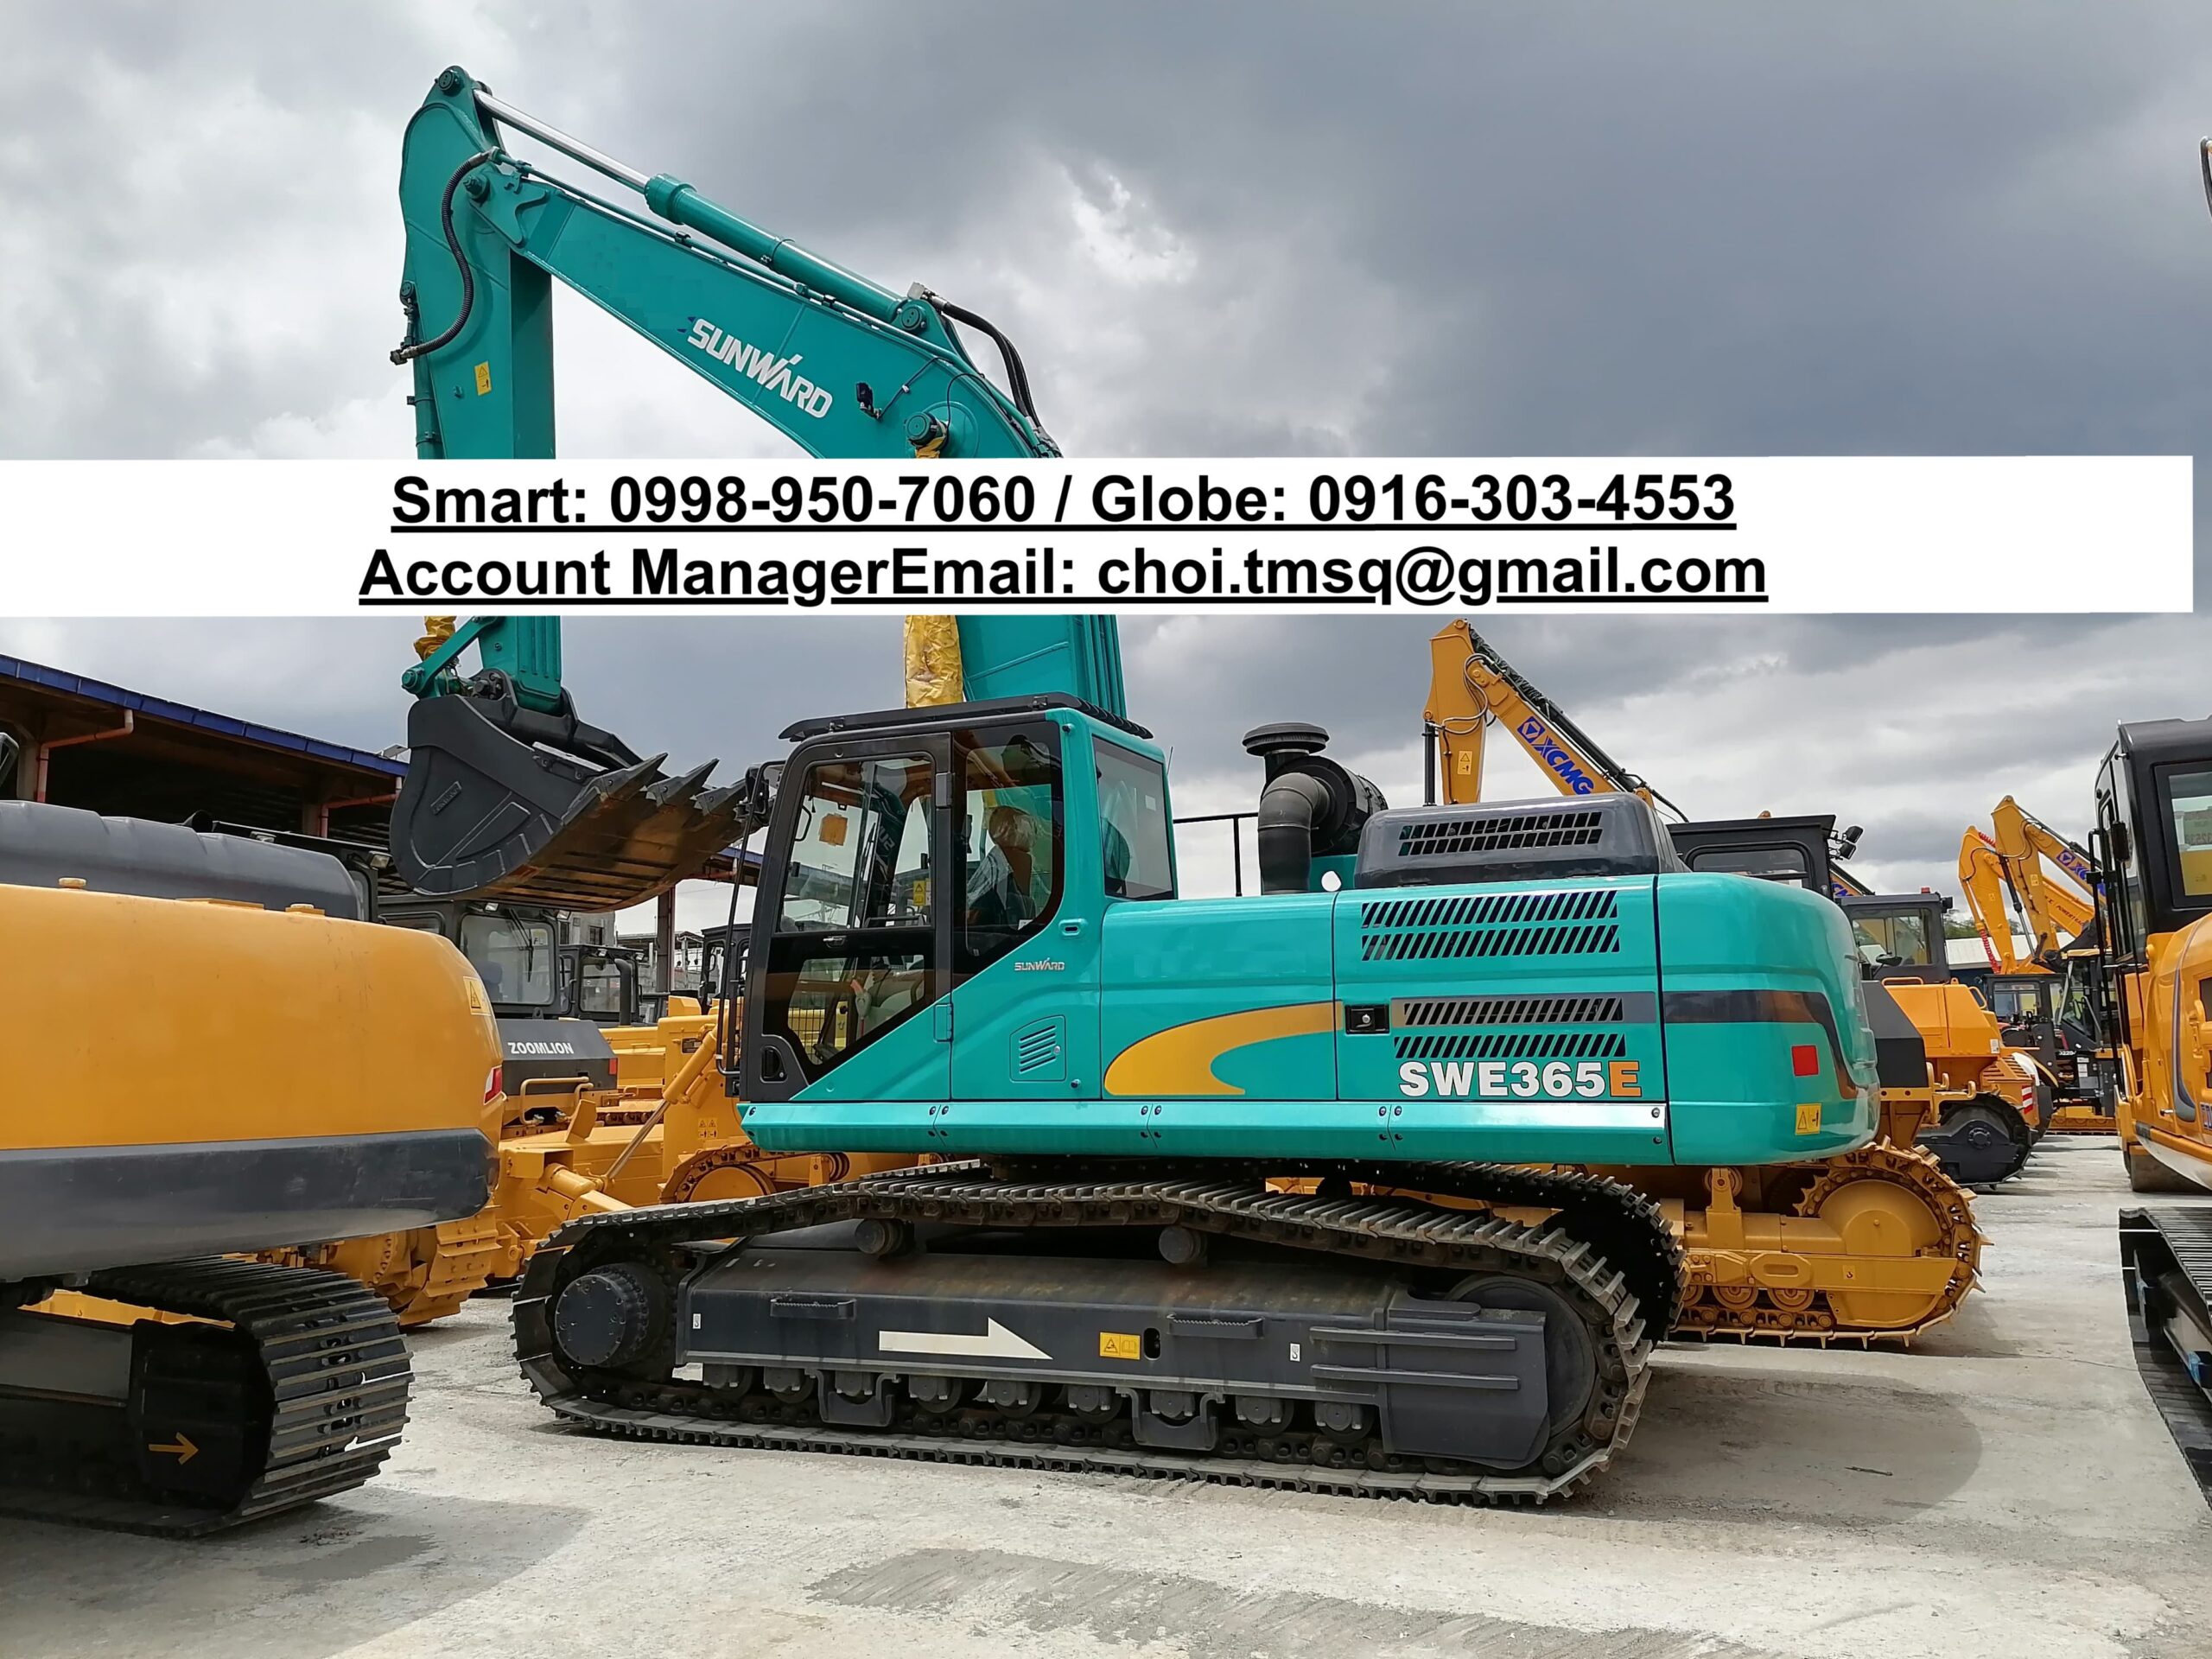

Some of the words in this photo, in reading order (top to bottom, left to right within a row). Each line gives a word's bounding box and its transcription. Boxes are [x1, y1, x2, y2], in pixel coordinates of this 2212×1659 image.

[687, 318, 833, 418] SUNWARD
[1531, 735, 1594, 796] XCMG
[1014, 957, 1065, 971] SUNWARD
[507, 1042, 574, 1054] ZOOMLION
[1398, 1061, 1643, 1097] SWE365E
